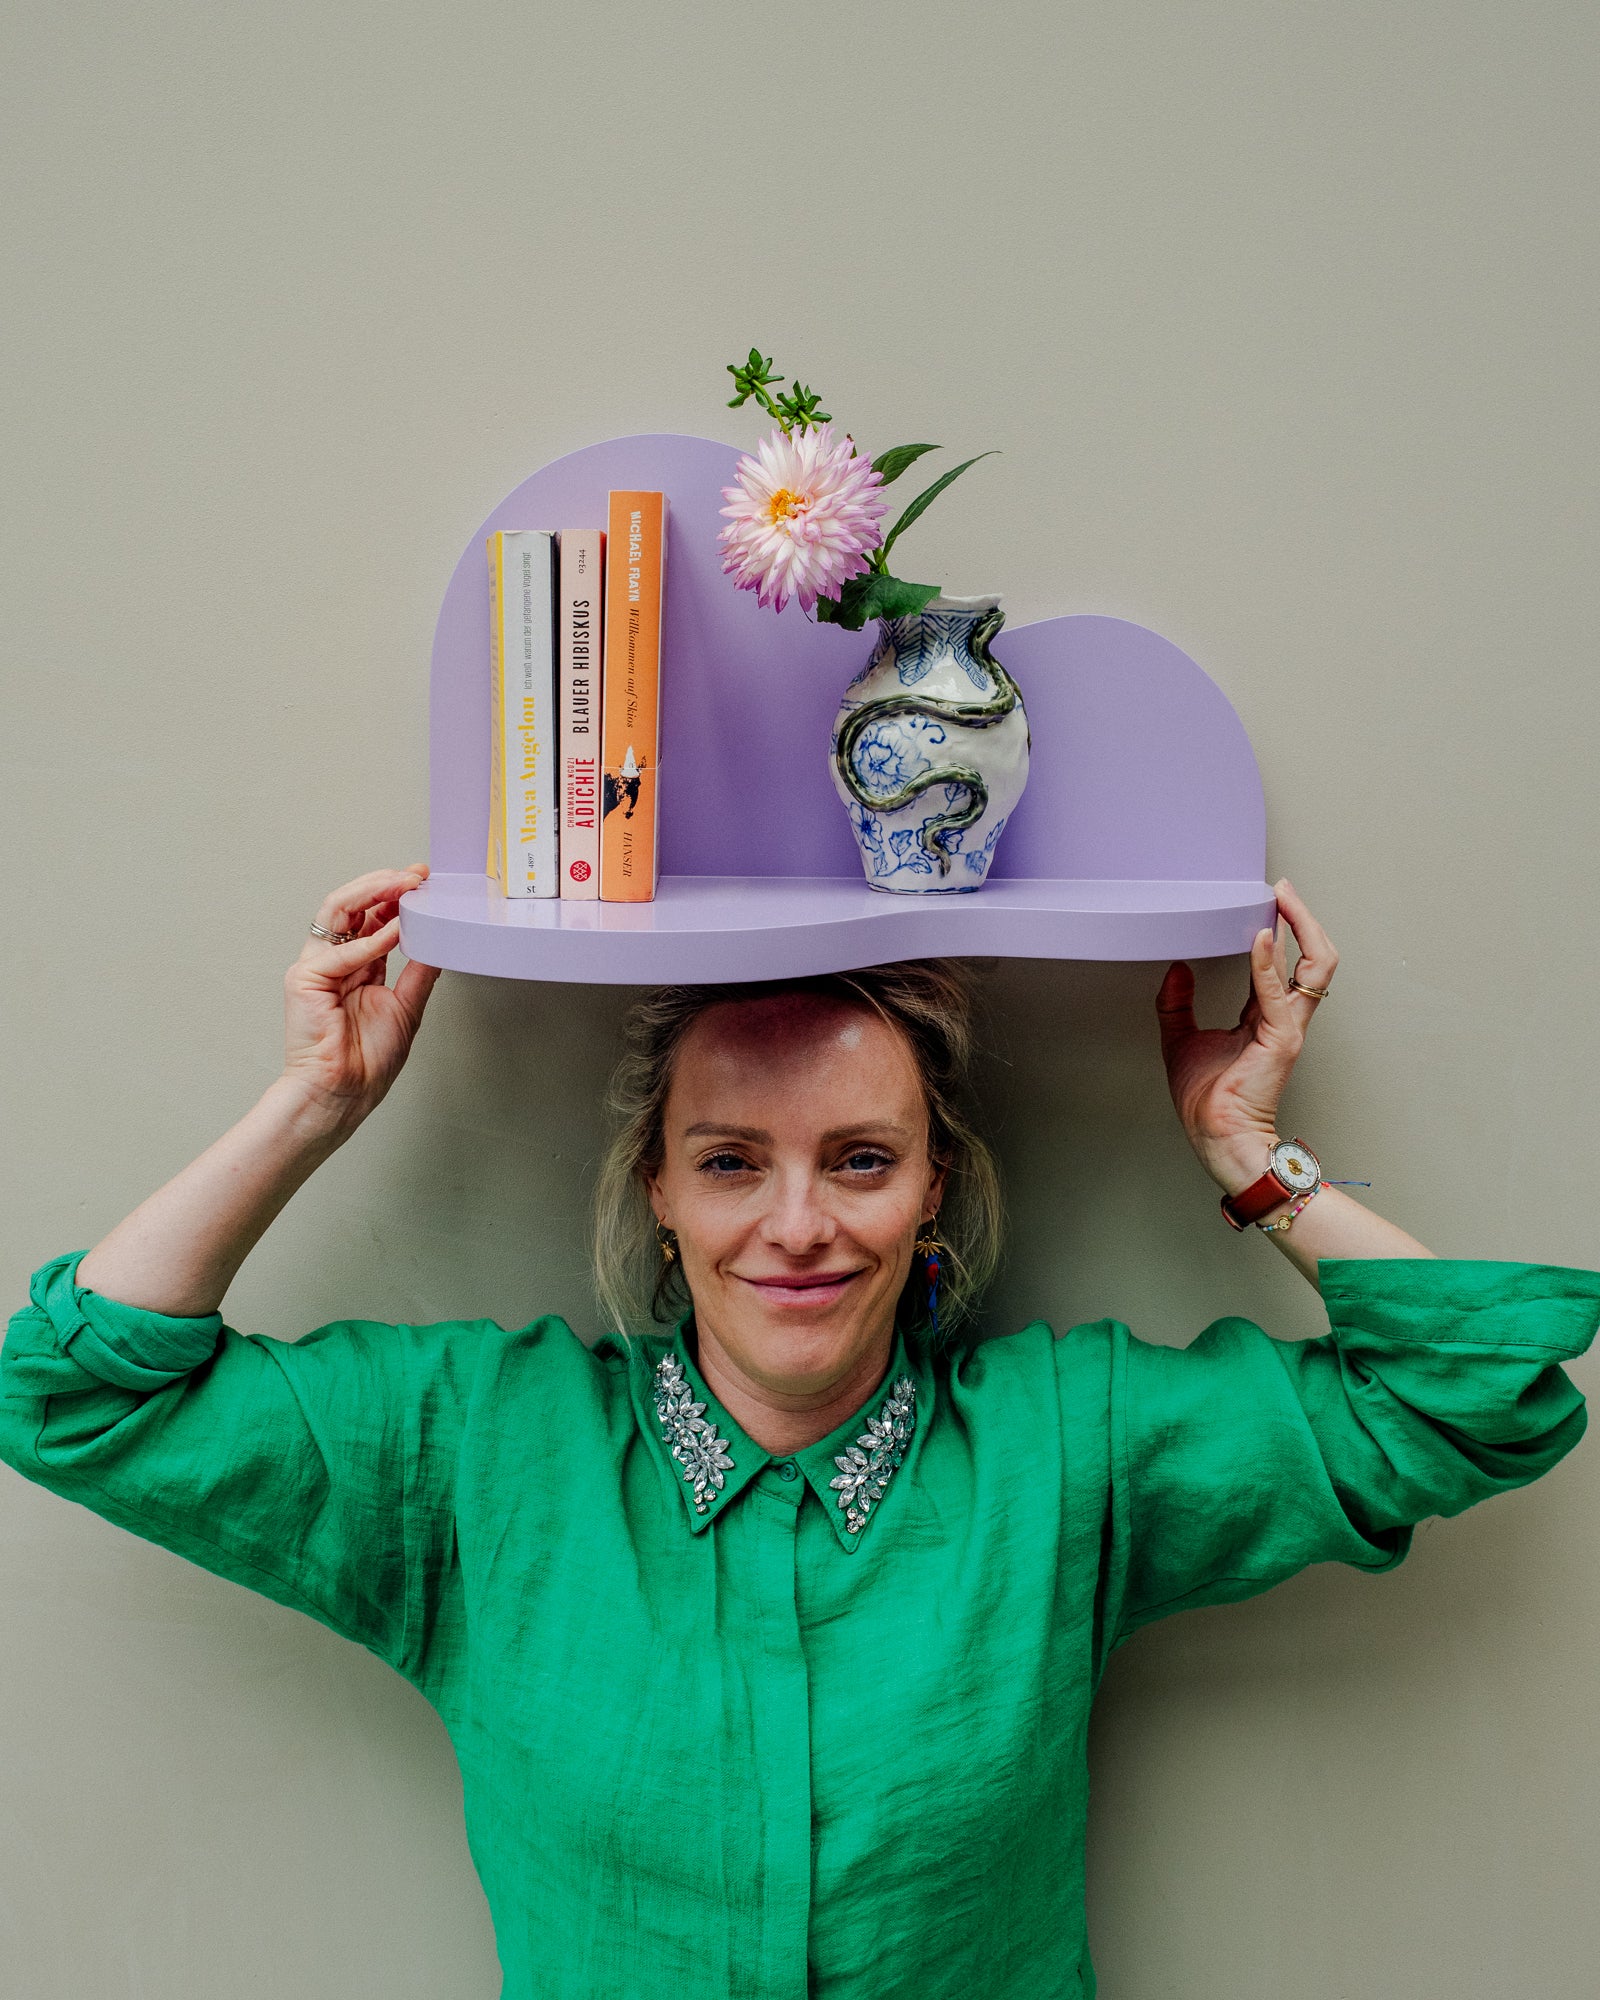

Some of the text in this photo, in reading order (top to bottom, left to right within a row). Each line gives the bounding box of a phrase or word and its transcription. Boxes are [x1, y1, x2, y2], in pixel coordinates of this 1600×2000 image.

[522, 552, 533, 568] singt
[577, 548, 587, 574] 03244
[628, 510, 643, 602] MICHAEL FRAYN
[522, 569, 533, 588] Vogel
[522, 589, 533, 624] gefangene
[523, 625, 533, 637] der
[524, 638, 533, 660] warum
[572, 600, 590, 735] BLAUER HIBISKUS
[624, 608, 641, 729] Willkommen auf Skios
[523, 680, 533, 690] Ich
[517, 697, 542, 844] Maya Angelou
[567, 757, 575, 829] CHIMAMANDA NGOZI
[575, 757, 595, 829] ADICHIE
[527, 853, 535, 869] 4897
[622, 831, 633, 877] HANSER
[526, 885, 537, 894] st
